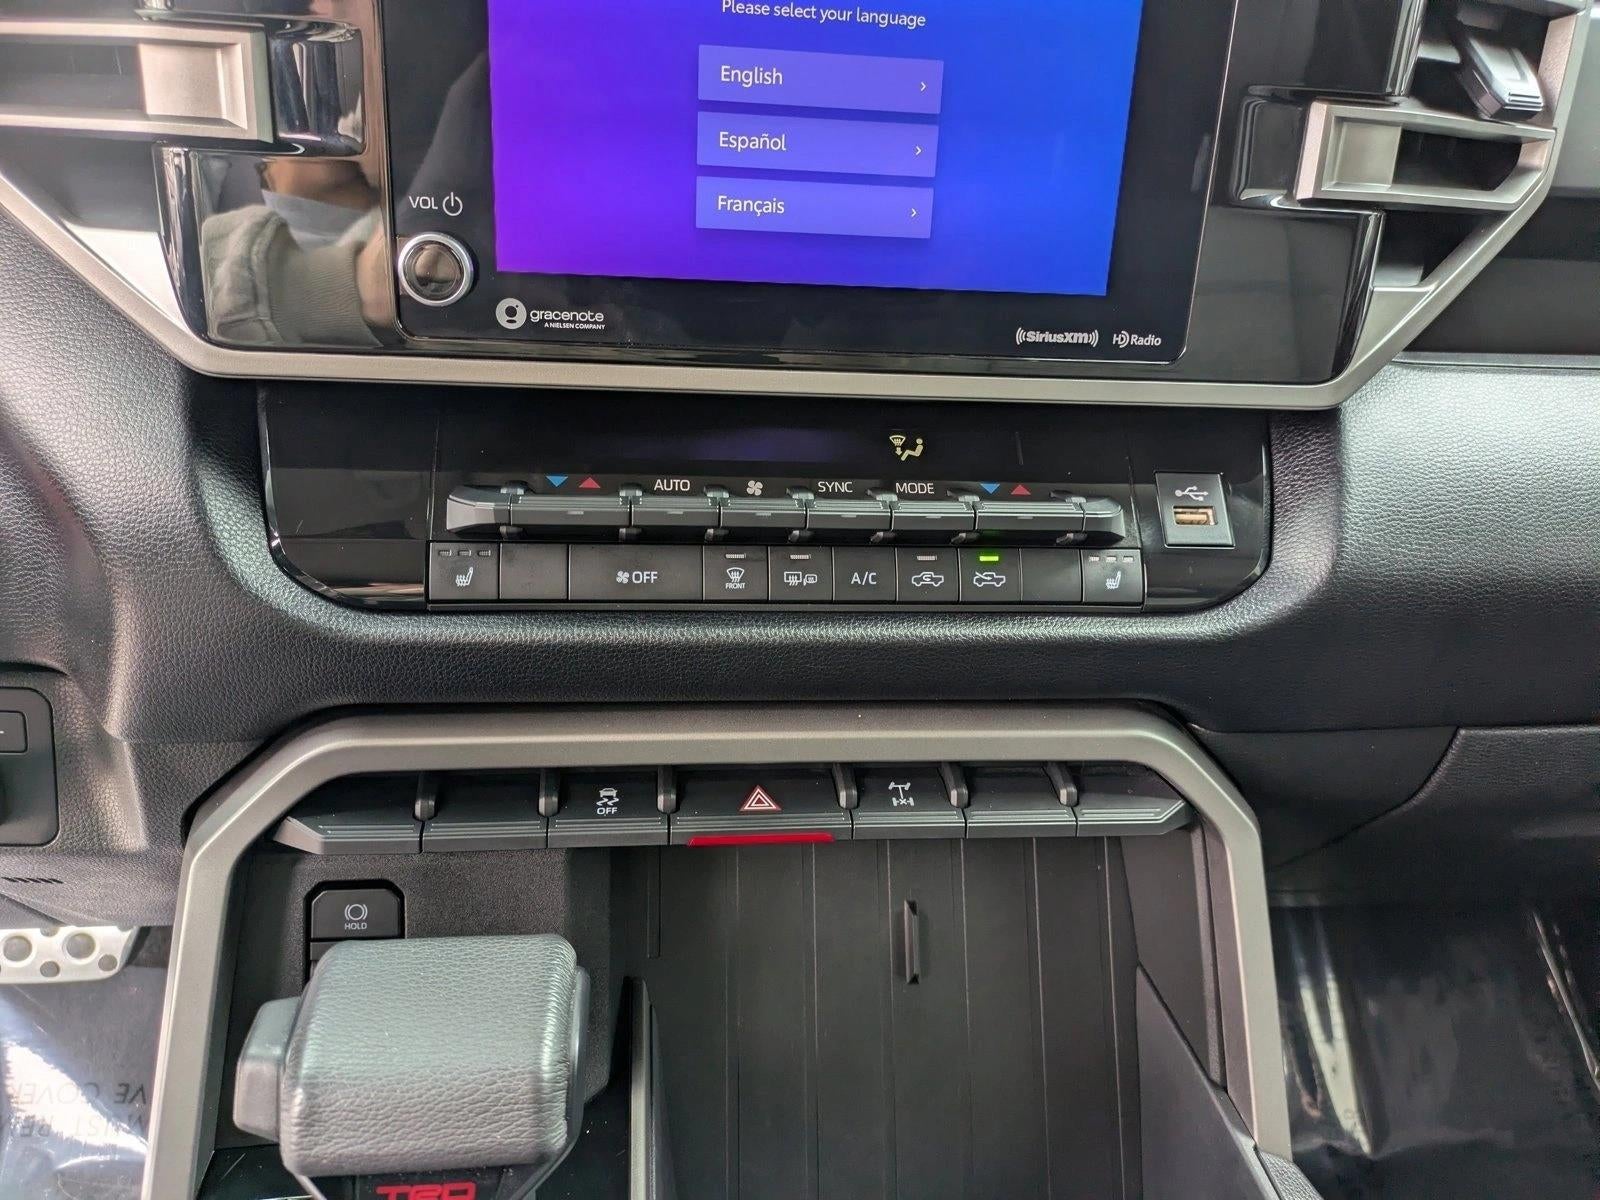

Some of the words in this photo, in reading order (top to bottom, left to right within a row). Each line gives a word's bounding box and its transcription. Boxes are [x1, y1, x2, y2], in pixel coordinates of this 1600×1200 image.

[722, 0, 770, 16] Please
[773, 2, 816, 19] select
[819, 8, 852, 24] your
[856, 7, 926, 29] language
[720, 65, 783, 88] English
[719, 131, 787, 152] Español
[408, 195, 438, 210] VOL
[717, 195, 785, 216] Français
[530, 309, 604, 323] gracenote
[1112, 331, 1130, 348] HD
[1130, 334, 1162, 346] Radio
[653, 479, 691, 492] AUTO
[817, 481, 853, 493] SYNC
[895, 482, 934, 494] MODE
[632, 571, 658, 583] OFF
[850, 571, 877, 585] A/C
[596, 806, 618, 815] OFF
[344, 922, 368, 930] HOLD
